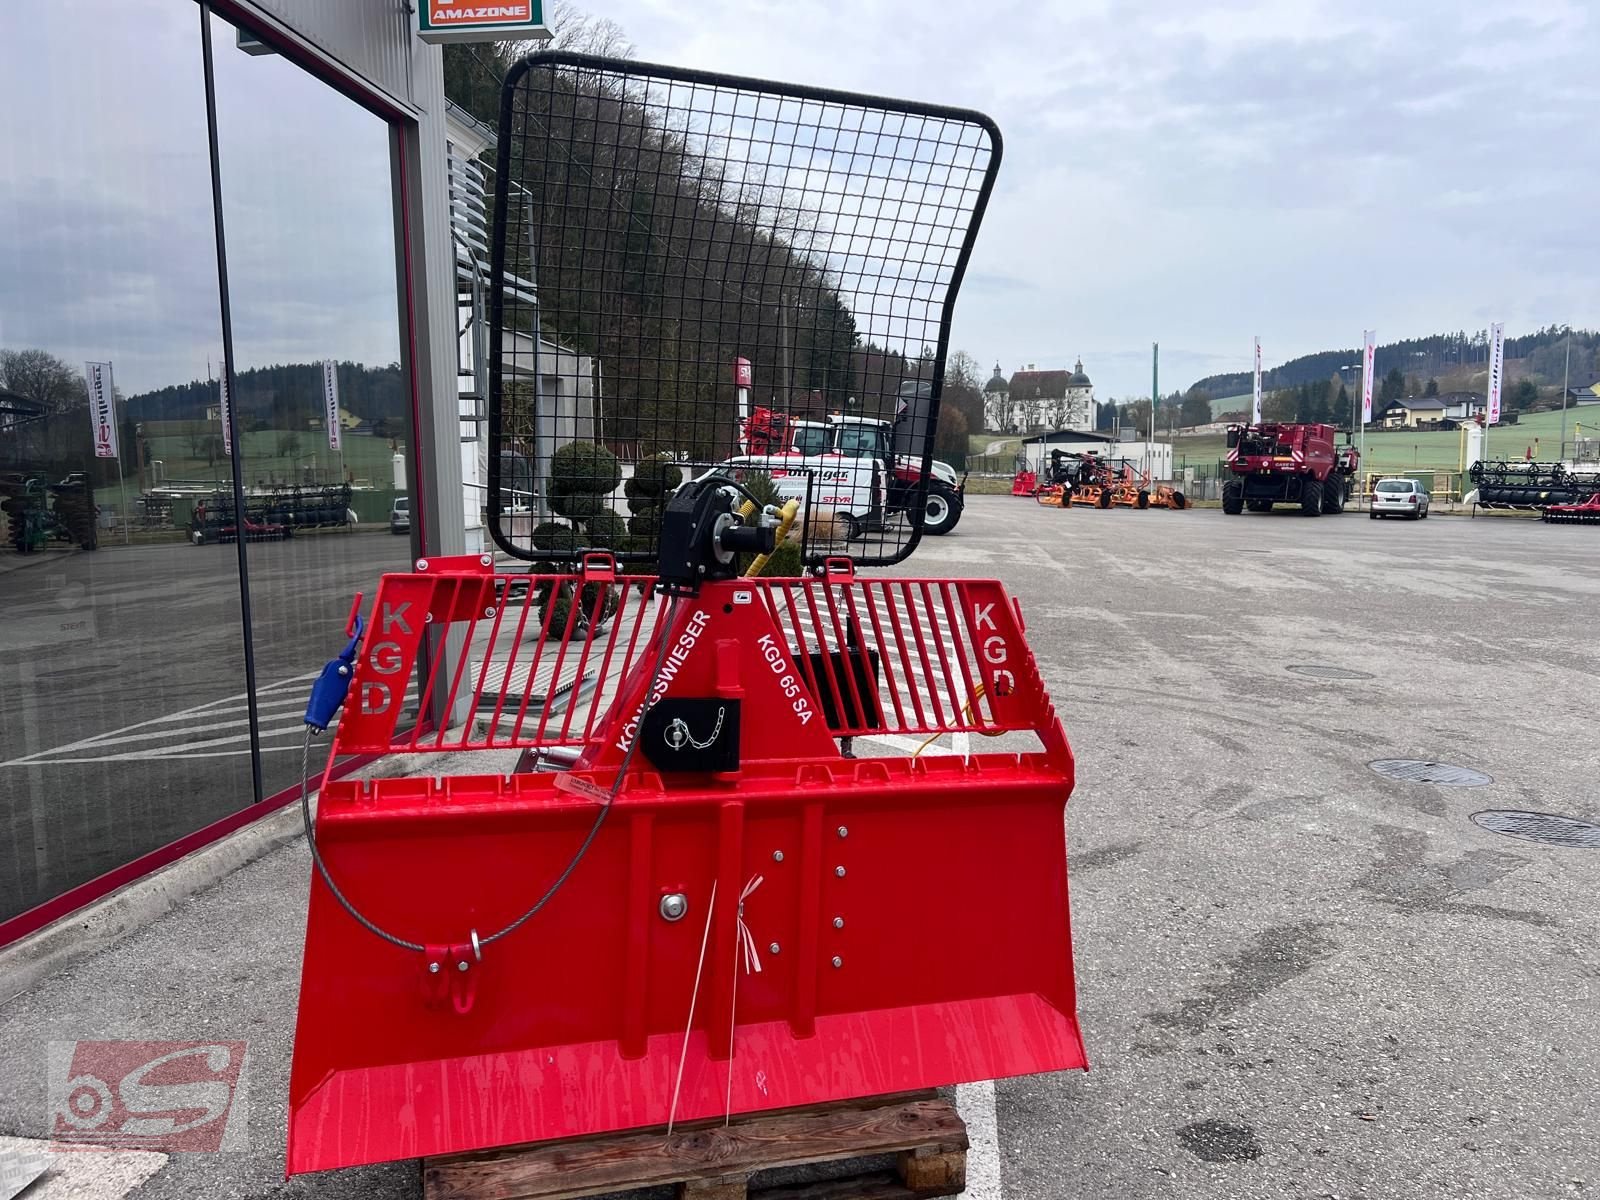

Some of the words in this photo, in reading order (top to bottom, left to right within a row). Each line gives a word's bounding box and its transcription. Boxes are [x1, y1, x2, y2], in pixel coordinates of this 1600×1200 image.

[433, 6, 526, 20] AMAZONE
[822, 496, 852, 504] STEYR
[758, 633, 787, 674] KGD
[780, 675, 800, 697] 65
[792, 698, 813, 725] SA
